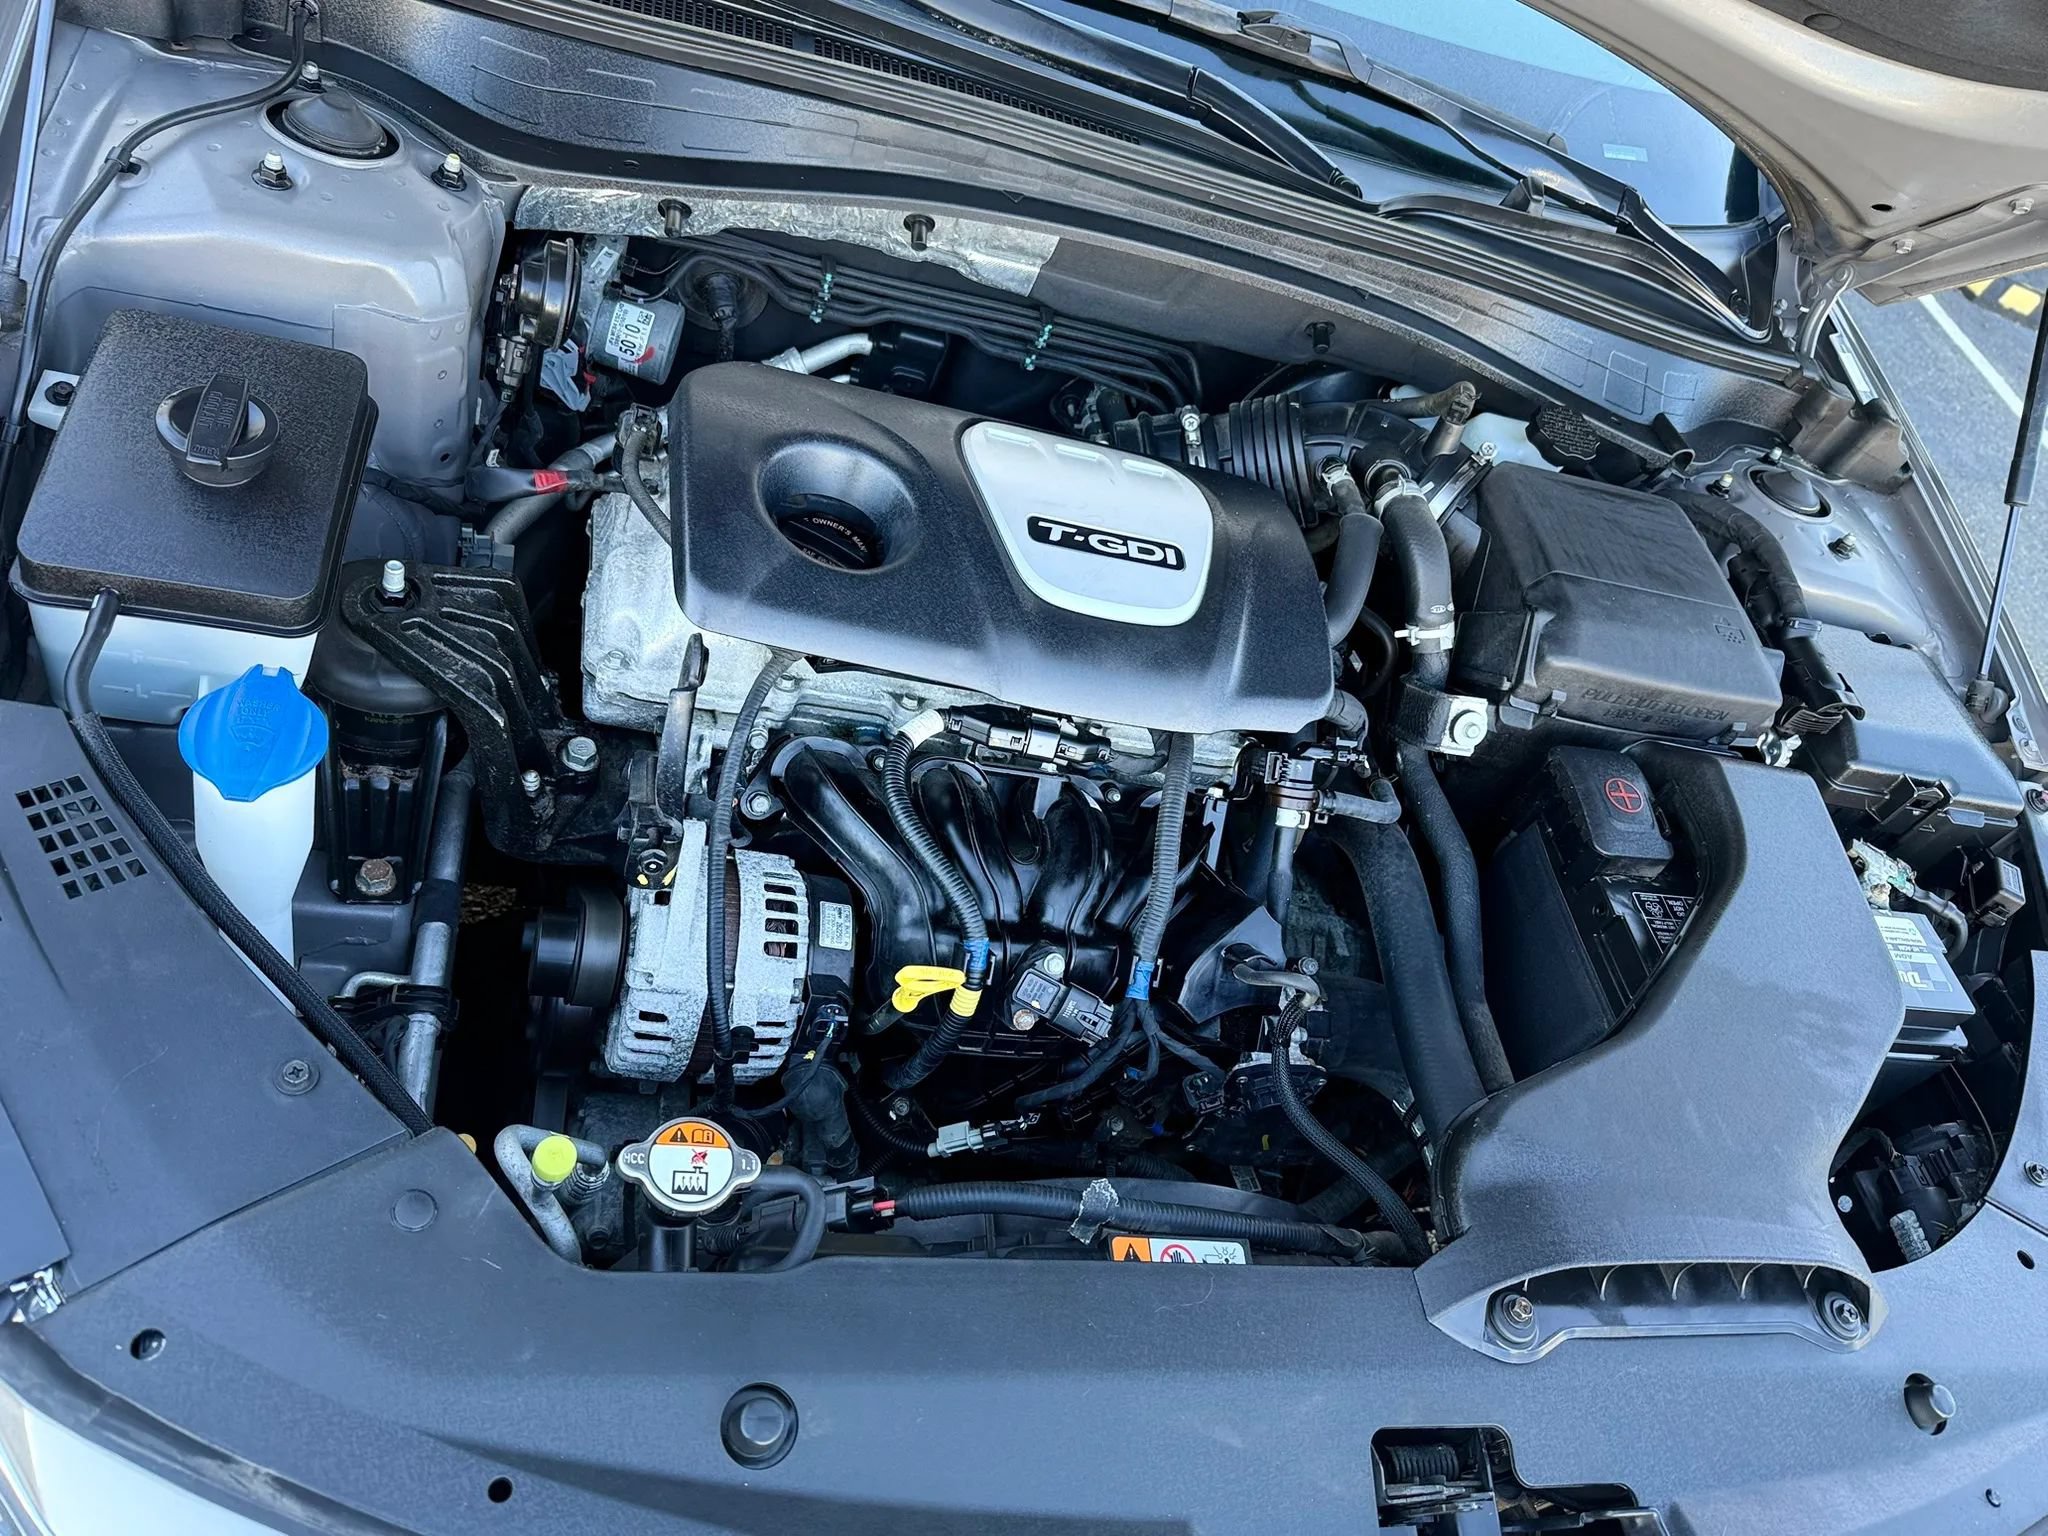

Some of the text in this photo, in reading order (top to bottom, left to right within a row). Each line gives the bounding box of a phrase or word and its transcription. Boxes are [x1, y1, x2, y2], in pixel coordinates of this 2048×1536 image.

[619, 324, 641, 356] 5010
[812, 517, 852, 536] OWNER'S
[741, 1158, 757, 1171] 1.1
